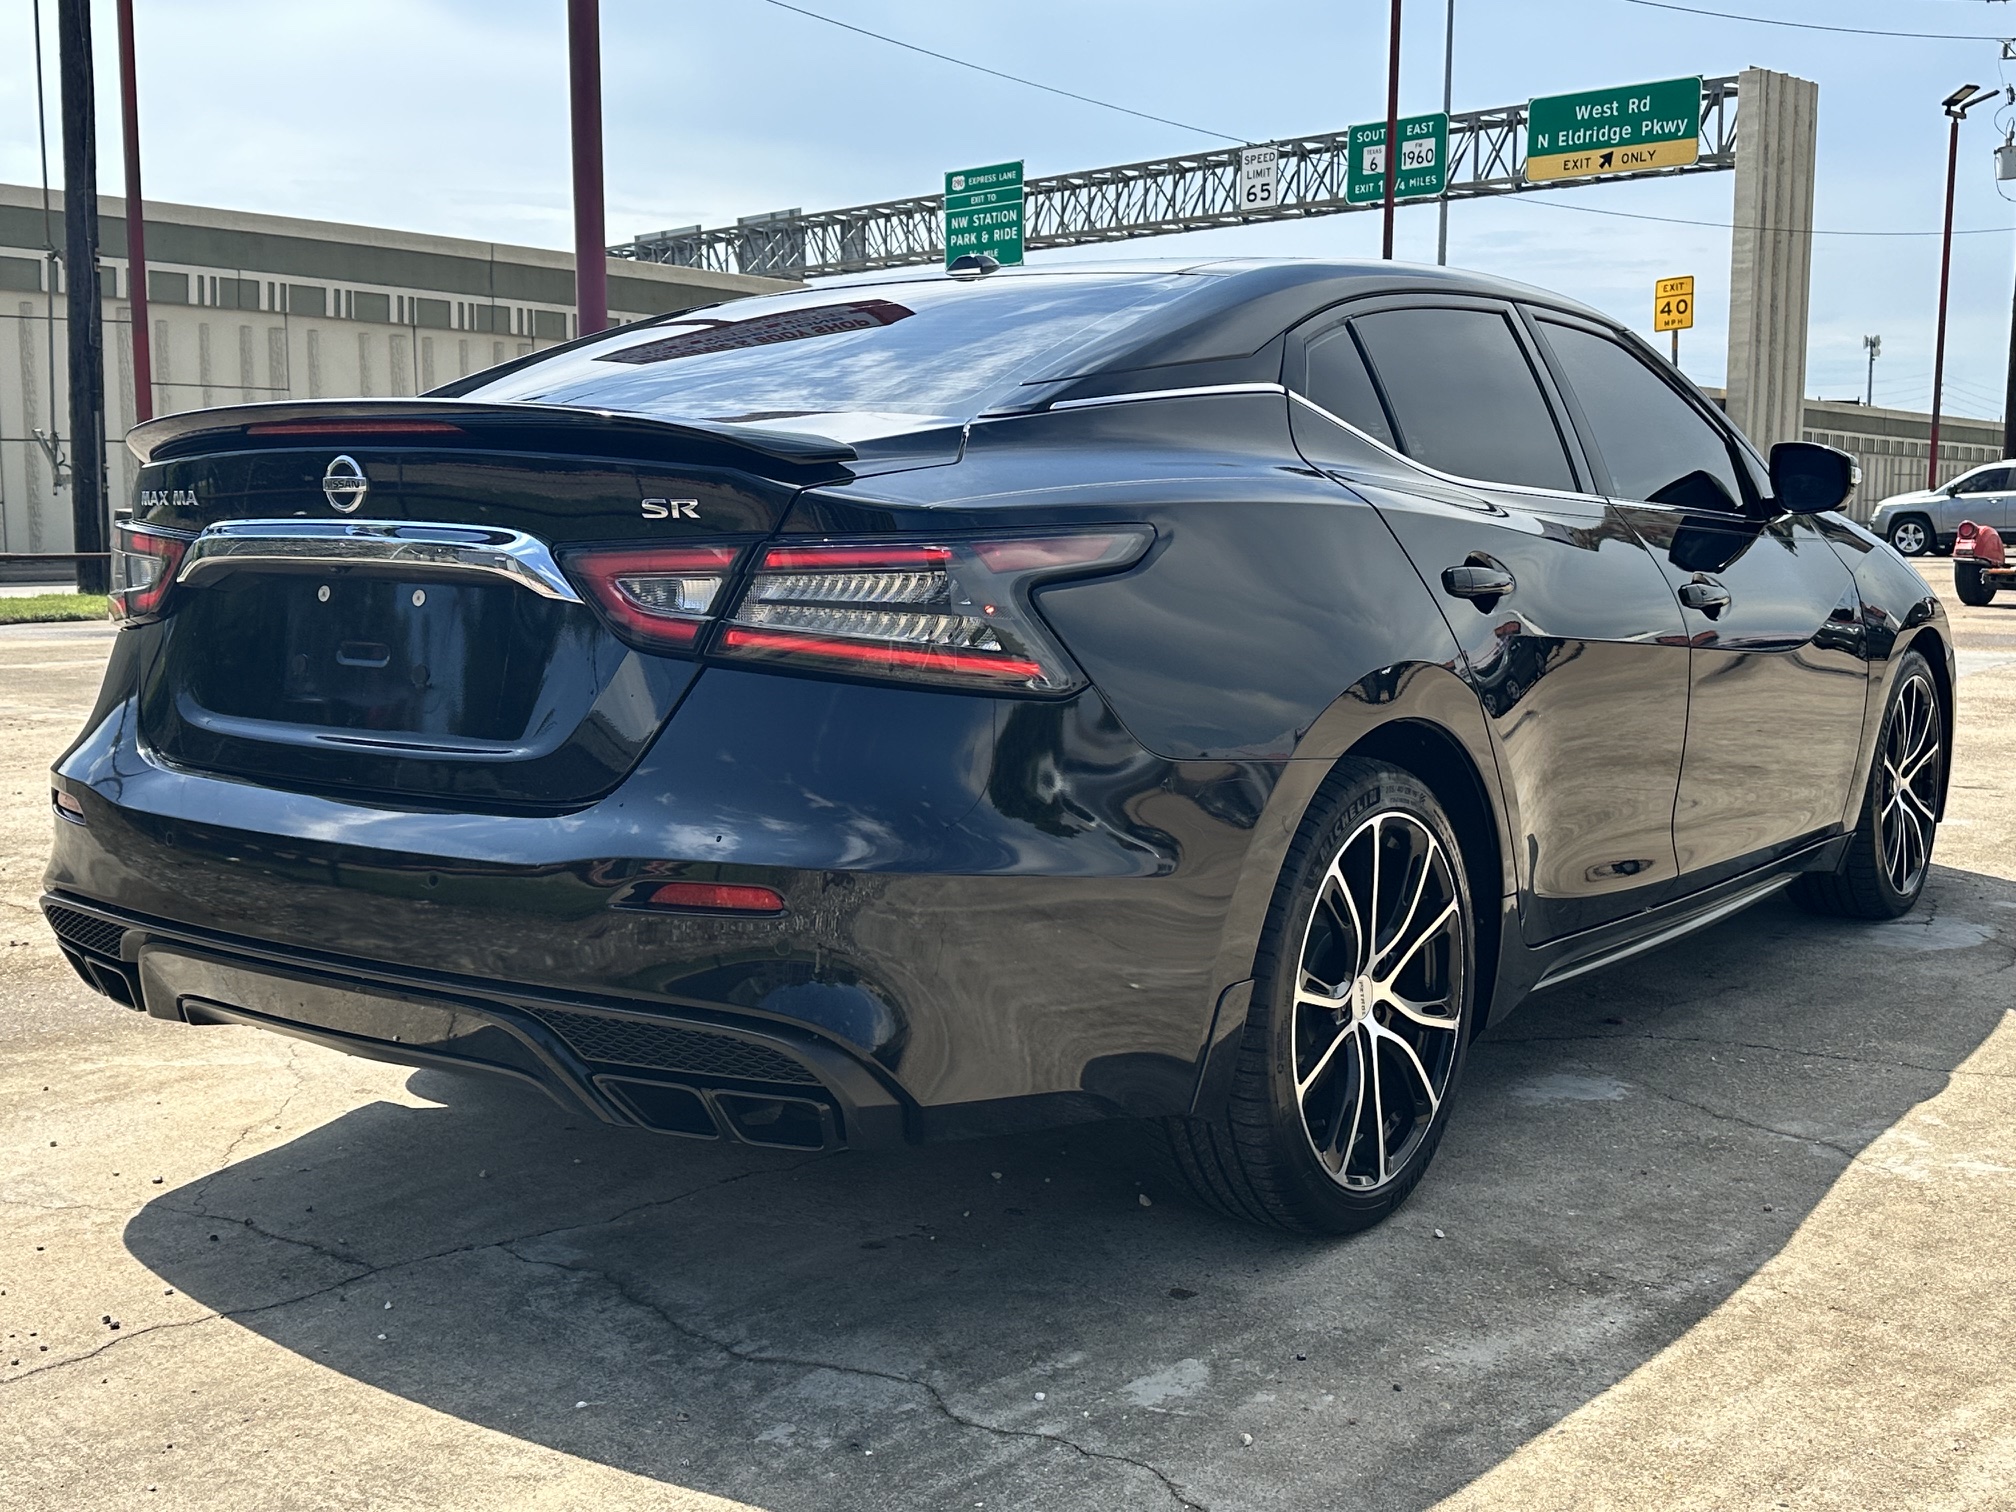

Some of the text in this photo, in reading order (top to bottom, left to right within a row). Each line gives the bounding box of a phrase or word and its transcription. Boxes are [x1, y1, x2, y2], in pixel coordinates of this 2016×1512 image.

[1576, 96, 1650, 120] West Rd
[1357, 129, 1386, 143] SOUT
[1406, 122, 1434, 136] EAST
[1538, 119, 1688, 149] N Eldridge Pkwy
[1244, 153, 1276, 165] SPEED
[1370, 157, 1378, 171] 6
[1403, 149, 1434, 167] 1960
[1563, 150, 1657, 171] EXIT ONLY
[968, 171, 1016, 185] EXPRESS LANE
[1247, 168, 1271, 180] LIMIT
[1246, 183, 1271, 203] 65
[1355, 184, 1374, 194] EXIT
[1409, 176, 1437, 188] MILES
[971, 196, 984, 204] EXIT
[951, 210, 1018, 229] NW STATION
[951, 227, 1018, 246] PARK & RIDE
[1663, 282, 1684, 292] EXIT
[1660, 299, 1688, 316] 40
[325, 480, 360, 489] NISSAN
[641, 498, 701, 519] SR
[1319, 787, 1380, 862] MICHELIN
